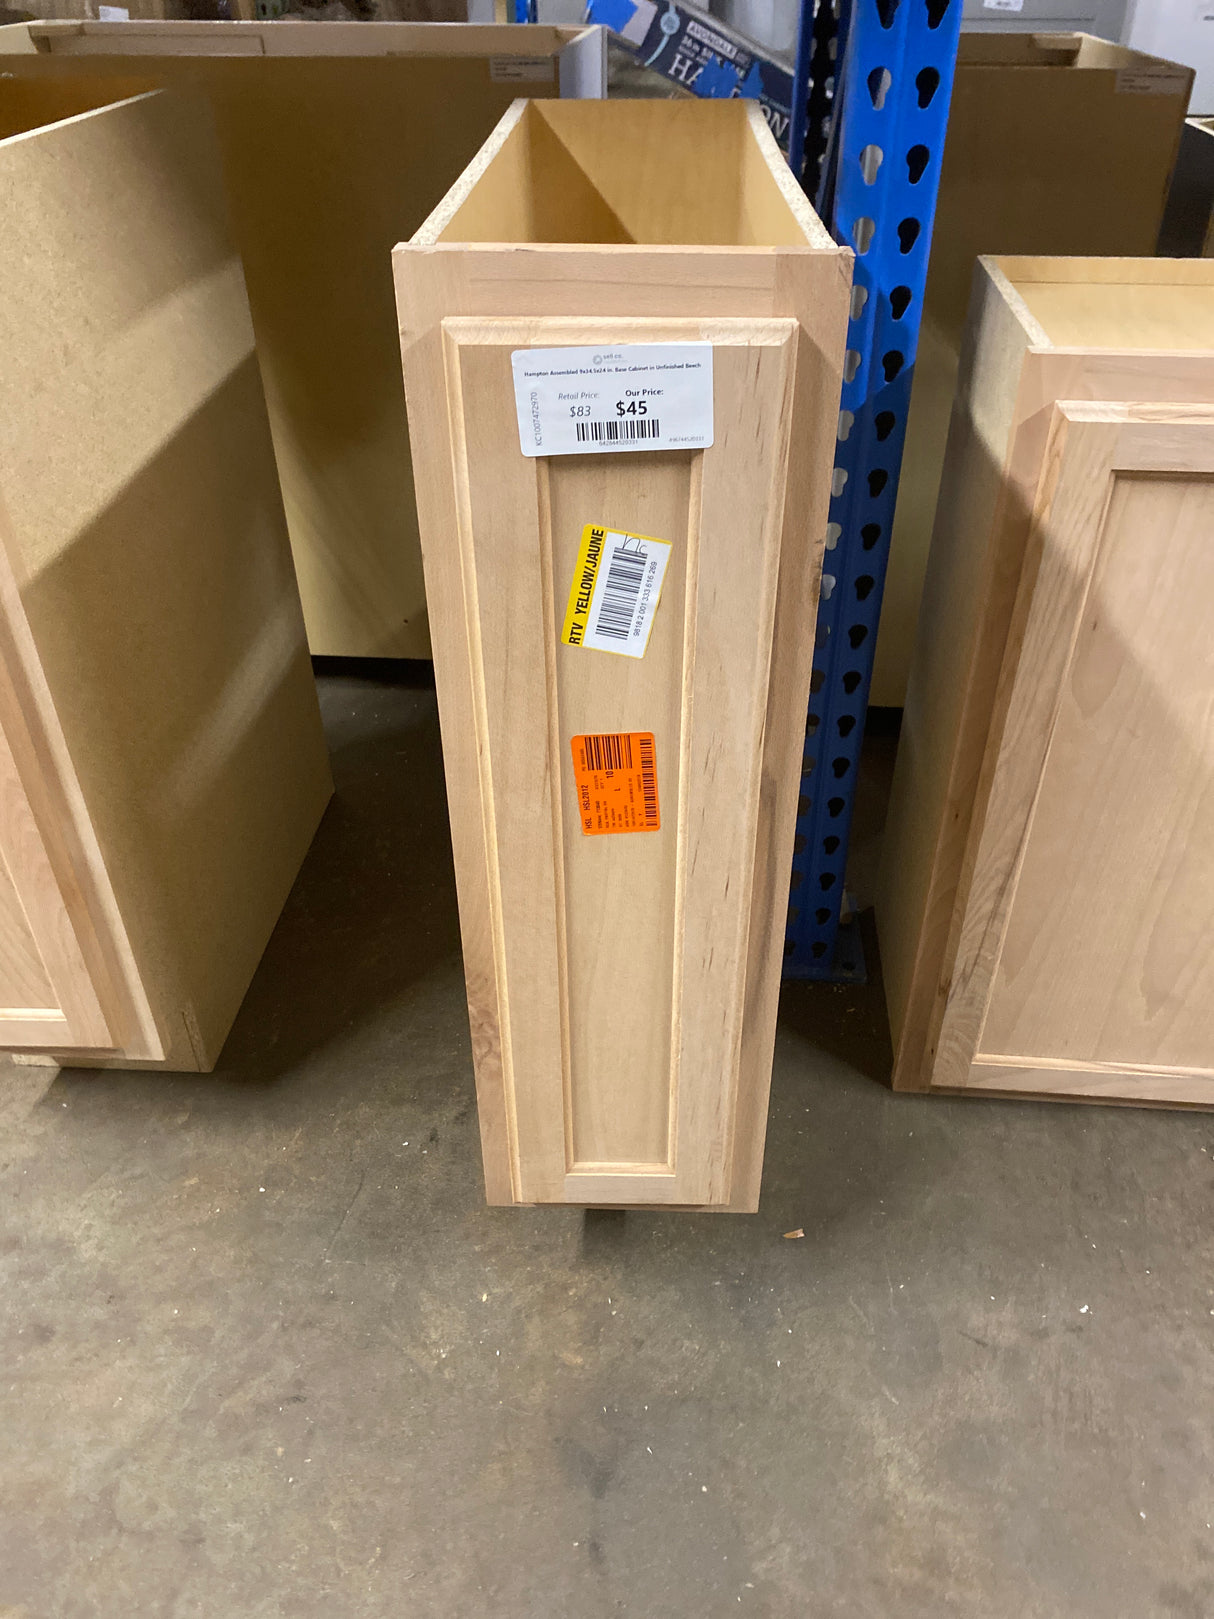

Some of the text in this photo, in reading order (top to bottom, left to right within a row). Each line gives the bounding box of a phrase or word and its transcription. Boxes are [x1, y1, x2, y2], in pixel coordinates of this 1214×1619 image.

[558, 391, 599, 400] Retail Price:
[625, 388, 664, 397] Our Price:
[570, 405, 591, 418] $83
[616, 400, 648, 418] $45
[568, 528, 604, 645] RTV YELLOW/JAUNE
[605, 770, 614, 779] 10
[580, 785, 593, 829] HSL HSL2012
